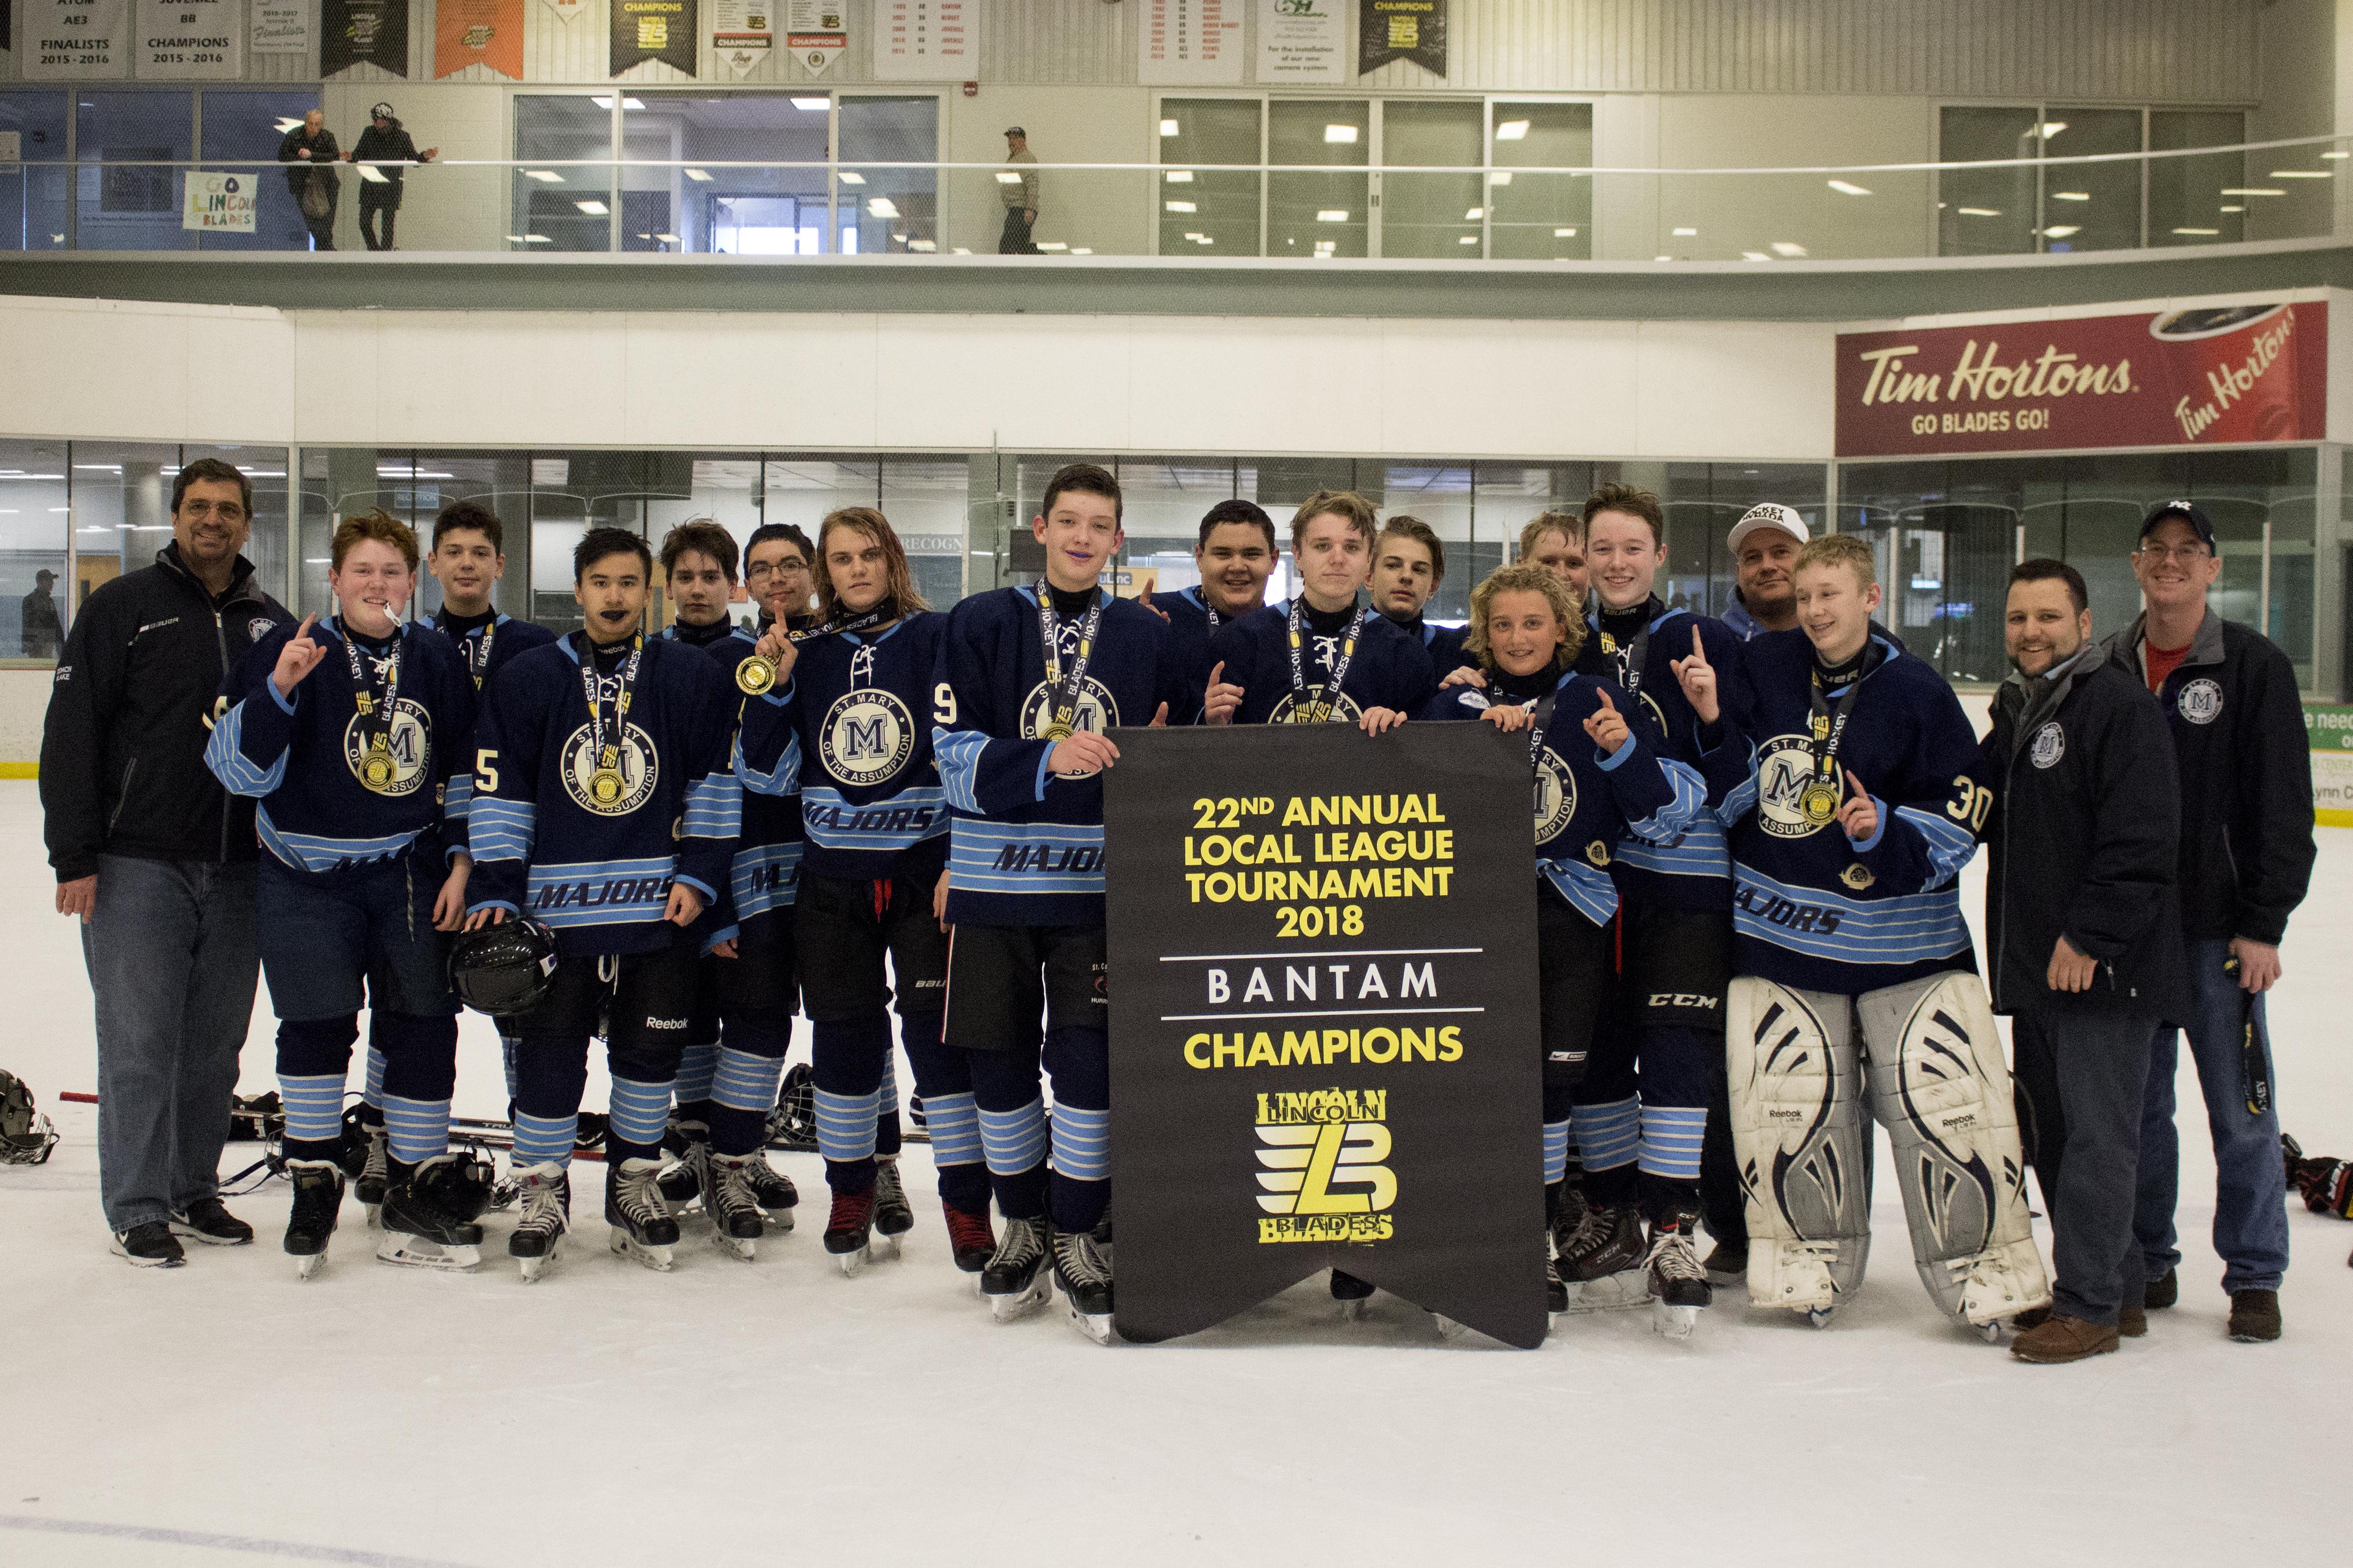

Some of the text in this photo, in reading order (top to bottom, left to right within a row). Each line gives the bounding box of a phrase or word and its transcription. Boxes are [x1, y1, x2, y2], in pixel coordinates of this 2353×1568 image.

[63, 16, 87, 25] AE3
[180, 14, 196, 23] BB
[624, 3, 682, 11] CHAMPIONS
[1375, 2, 1433, 11] CHAMPIONS
[41, 39, 109, 49] FINALISTS
[148, 38, 229, 48] CHAMPIONS
[717, 38, 767, 46] CHAMPIONS
[792, 38, 841, 46] CHAMPIONS
[41, 55, 70, 64] 2015
[80, 55, 109, 64] 2016
[153, 54, 184, 63] 2015
[193, 54, 223, 63] 2016
[206, 176, 240, 194] GO
[203, 213, 251, 226] BLADES
[1860, 338, 2131, 406] Tim Hortons
[1912, 409, 2049, 435] GO BLADES GO!
[2175, 395, 2219, 440] Tim
[1041, 608, 1054, 646] HOCKEY
[1084, 605, 1100, 640] HOCKEY
[347, 639, 363, 680] HOCKEY
[478, 635, 493, 667] BLADES
[626, 650, 641, 682] BLADES
[582, 666, 597, 702] BLADES
[1067, 657, 1087, 696] BLADES
[1291, 648, 1303, 691] HOCKEY
[1328, 655, 1350, 693] BLADES
[381, 684, 397, 722] BLADES
[394, 702, 422, 718] ARY
[834, 693, 896, 715] ST. MARY
[933, 683, 957, 724] 9
[842, 713, 889, 761] M
[1771, 739, 1793, 753] ST.
[1827, 713, 1847, 755] HOCKEY
[475, 748, 499, 793] 5
[823, 734, 911, 783] OF THE ASSUMPTION
[565, 769, 577, 785] OF
[1947, 775, 1993, 833] 30
[2314, 786, 2340, 801] ynn
[1192, 793, 1446, 829] 22ND ANNUAL
[1761, 814, 1812, 837] ASSUMP
[992, 843, 1106, 873] MAJO
[1184, 829, 1454, 866] LOCAL LEAGUE
[1185, 866, 1454, 903] TOURNAMENT
[1275, 905, 1365, 938] 2018
[1734, 886, 1846, 936] AJORS
[915, 980, 947, 988] BAU
[1208, 962, 1438, 1004] BANTAM
[1648, 993, 1719, 1010] CCM
[646, 1016, 689, 1029] Reebok
[1184, 1026, 1464, 1070] CHAMPIONS
[1255, 1087, 1387, 1125] LINCOLN
[1267, 1103, 1379, 1122] LINCOLN
[1941, 1113, 1976, 1128] Reebok
[1277, 1216, 1378, 1233] BLADES
